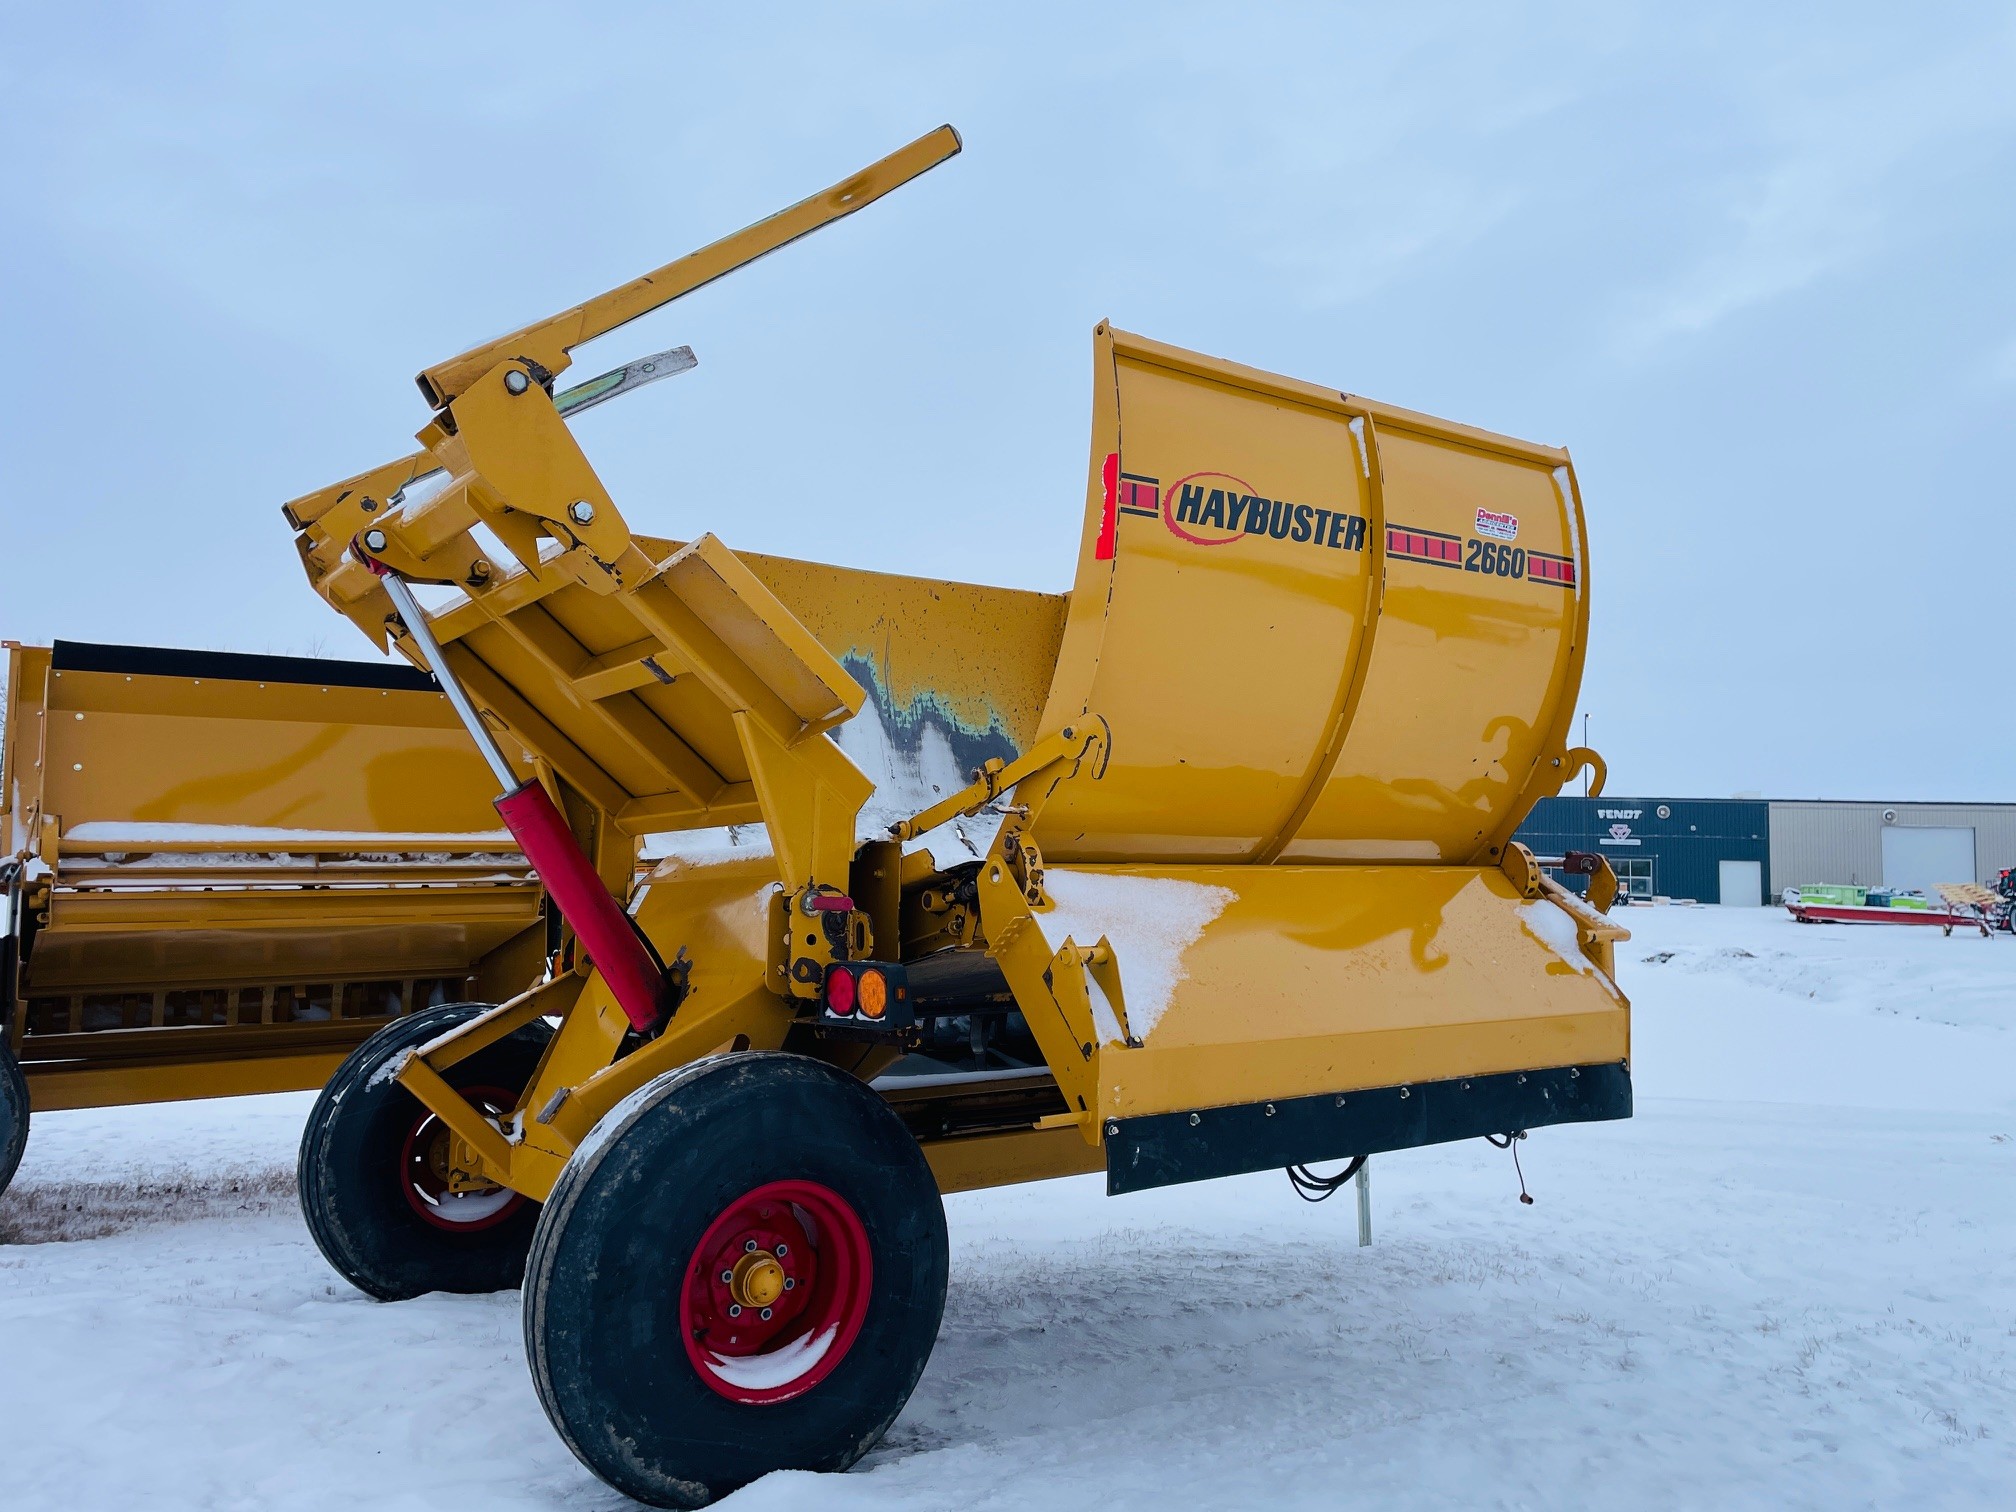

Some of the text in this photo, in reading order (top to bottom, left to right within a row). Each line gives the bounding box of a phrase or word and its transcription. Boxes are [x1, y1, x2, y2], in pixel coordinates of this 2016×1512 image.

[1176, 483, 1367, 552] HAYBUSTER
[1464, 538, 1526, 579] 2660
[1597, 809, 1643, 820] FENDT
